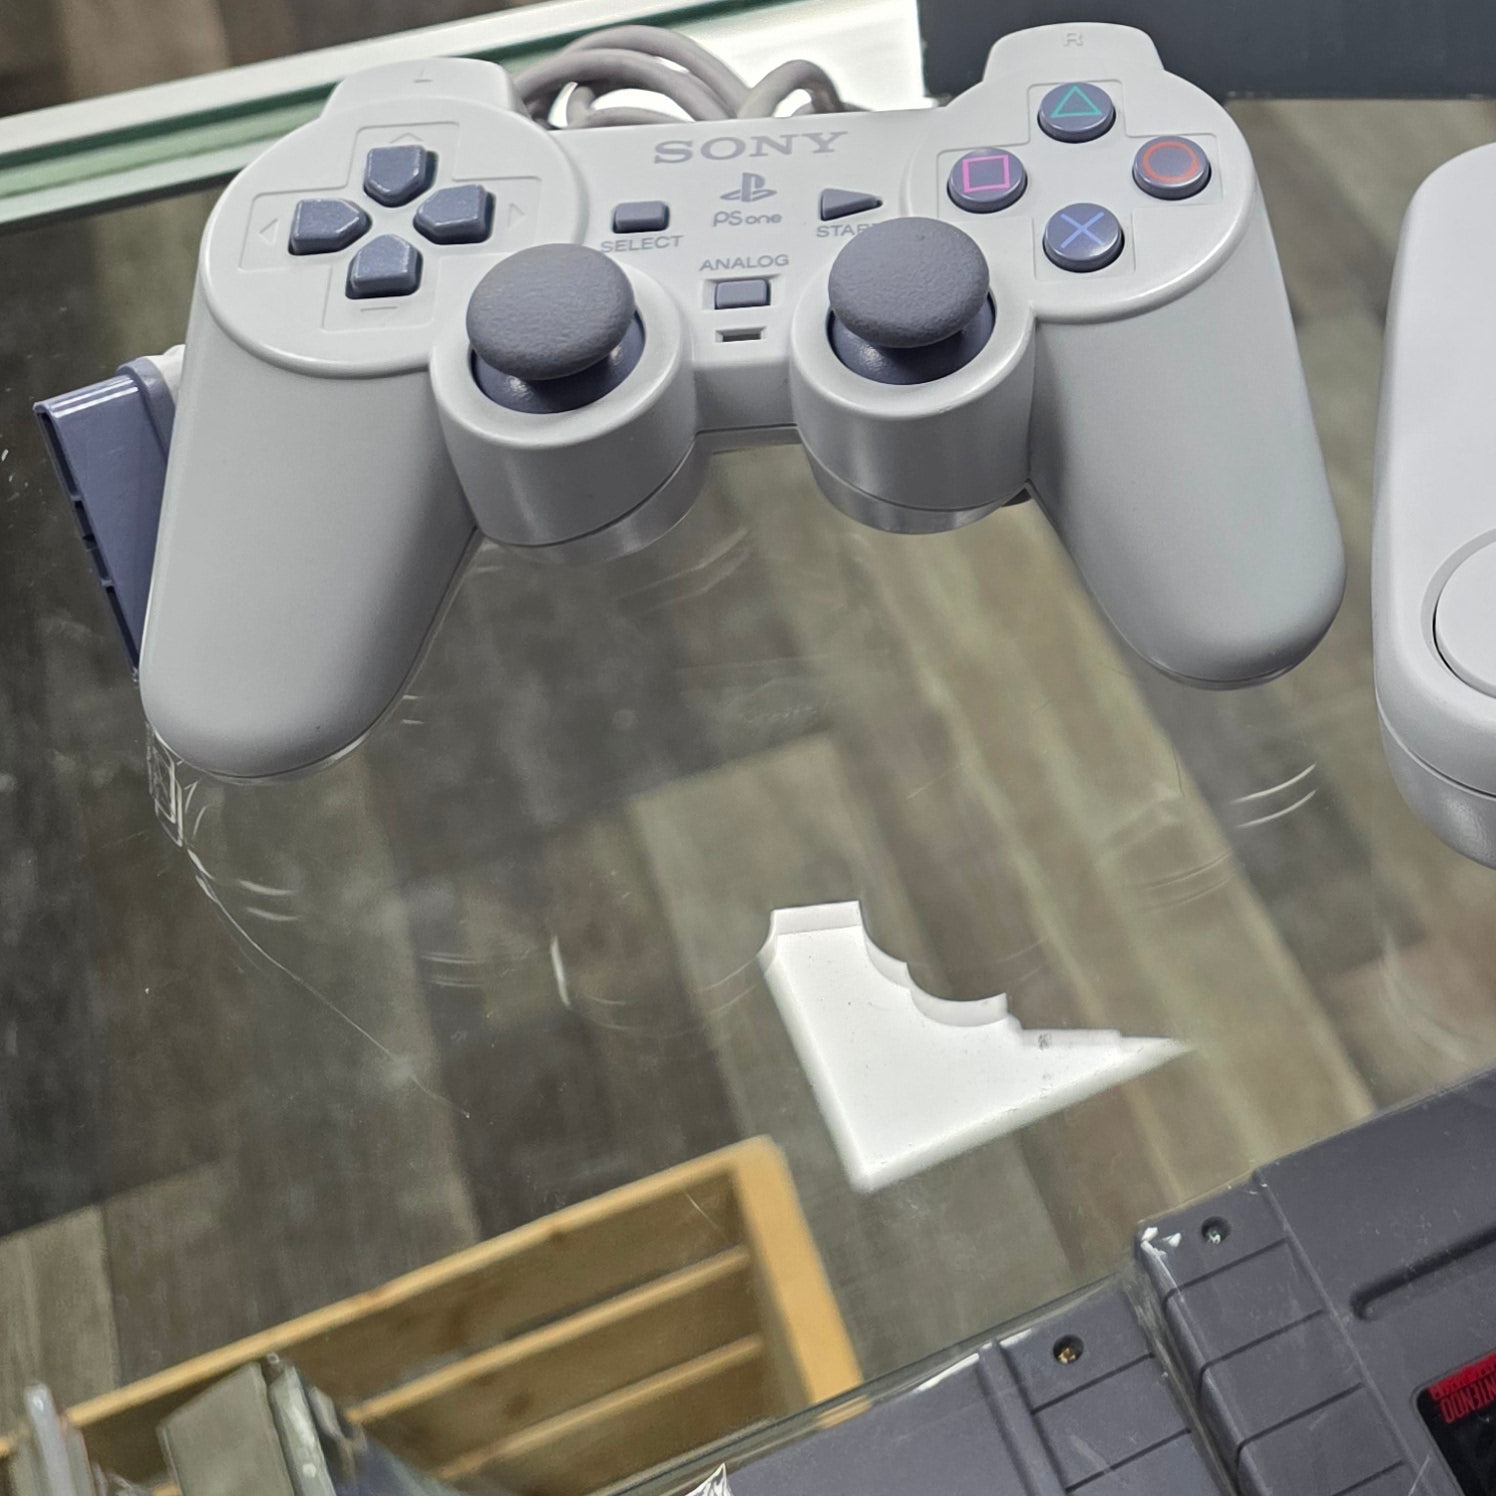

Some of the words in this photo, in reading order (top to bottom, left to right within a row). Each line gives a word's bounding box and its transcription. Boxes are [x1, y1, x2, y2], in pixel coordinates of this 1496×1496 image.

[654, 131, 848, 164] SONY
[712, 210, 744, 228] PS
[744, 213, 783, 225] one
[600, 234, 684, 253] SELECT
[699, 254, 790, 272] ANALOG
